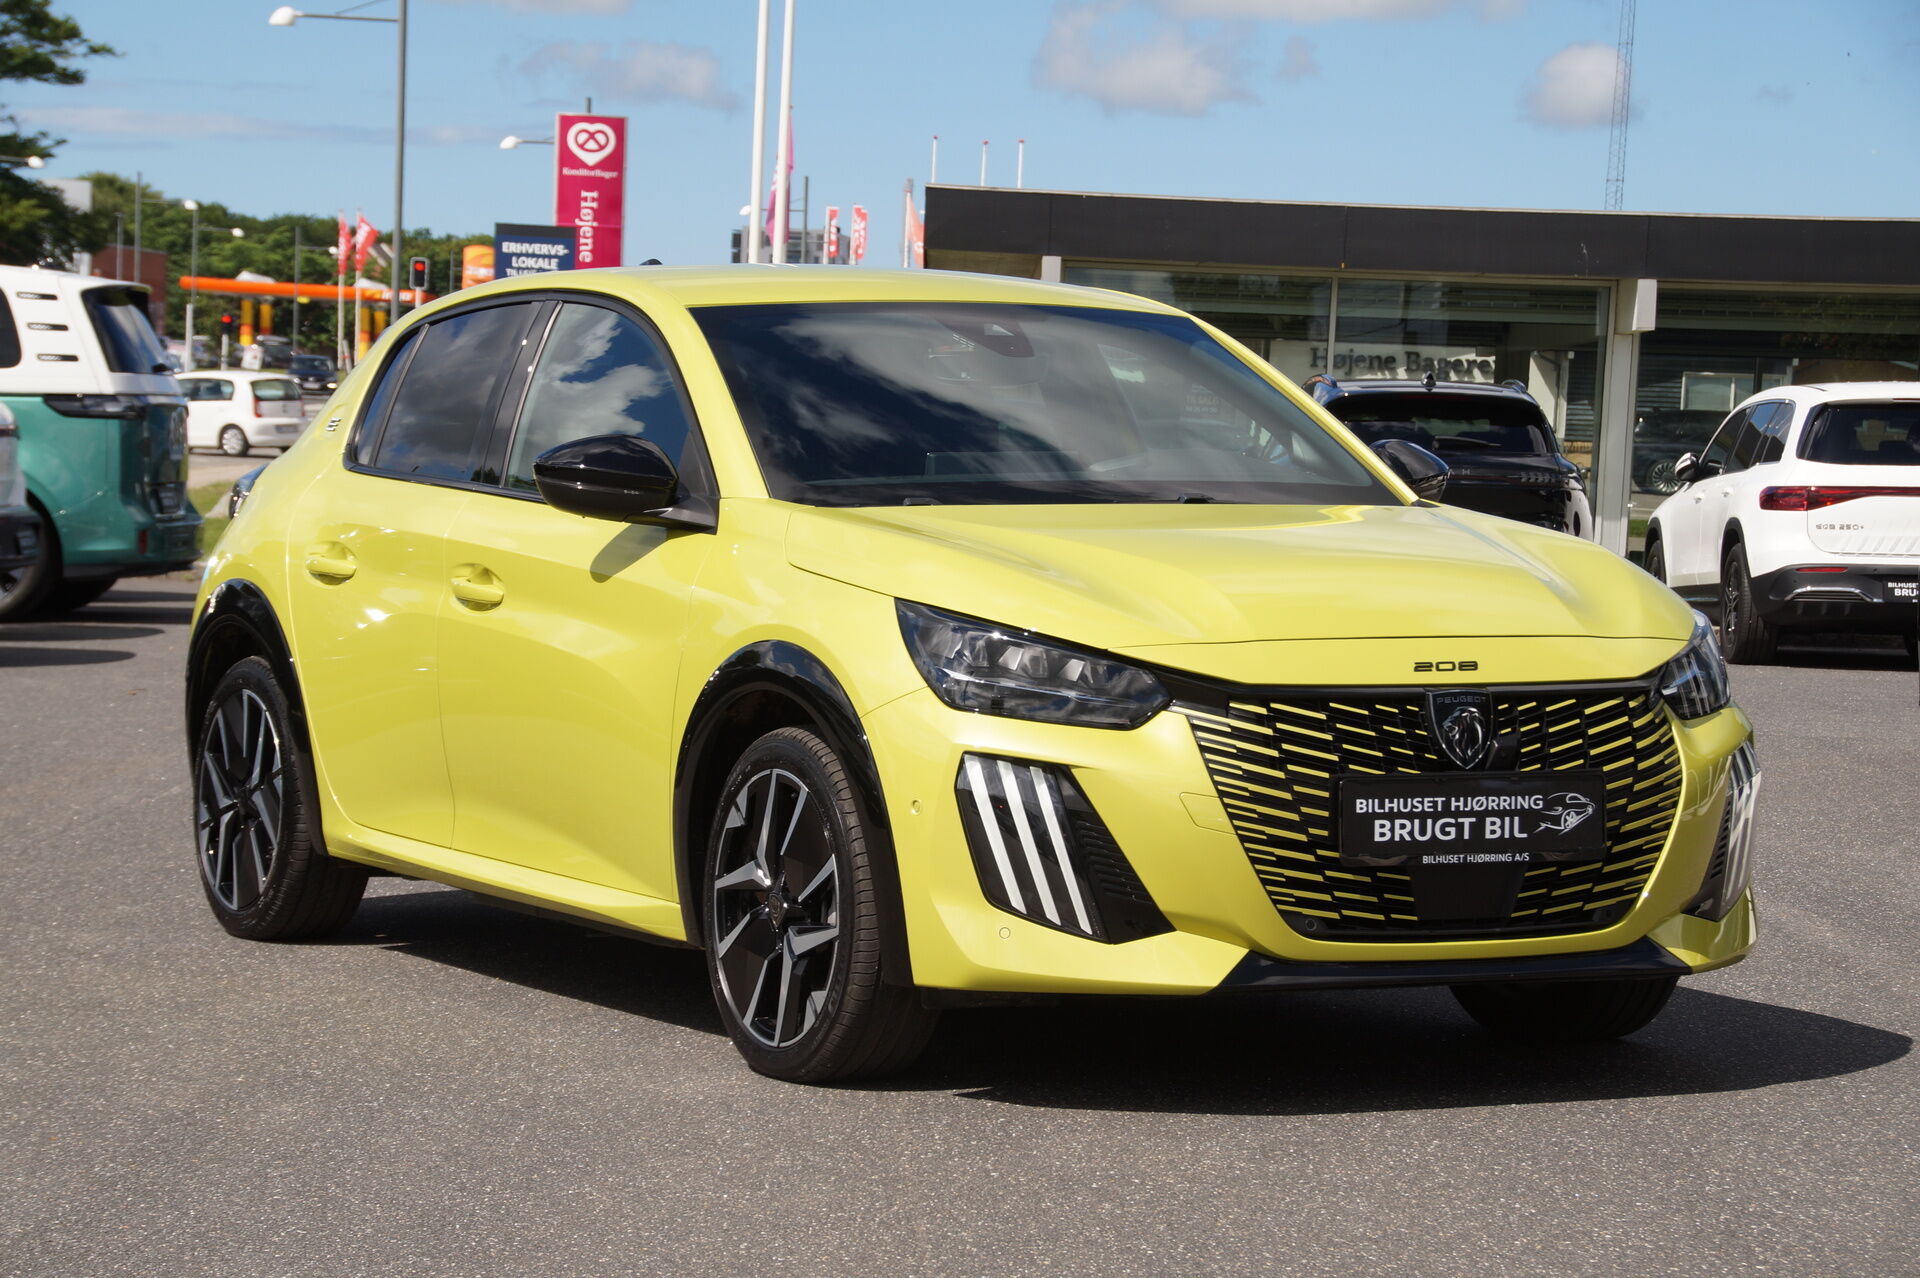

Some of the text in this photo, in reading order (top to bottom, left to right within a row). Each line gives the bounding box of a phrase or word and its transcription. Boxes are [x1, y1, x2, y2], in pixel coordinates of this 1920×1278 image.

[574, 190, 599, 263] Højene
[502, 241, 569, 256] ERHVERVS-
[511, 256, 559, 269] LOKALE
[1310, 347, 1495, 380] Højene Bagere
[1894, 588, 1919, 597] BRU
[1413, 661, 1479, 672] 208
[1437, 695, 1486, 704] PEUGEOT
[1356, 795, 1544, 813] BILHUSET HJØRRING
[1374, 816, 1528, 842] BRUGT BIL
[1422, 853, 1530, 864] BILHUSET HJØRRING A/S
